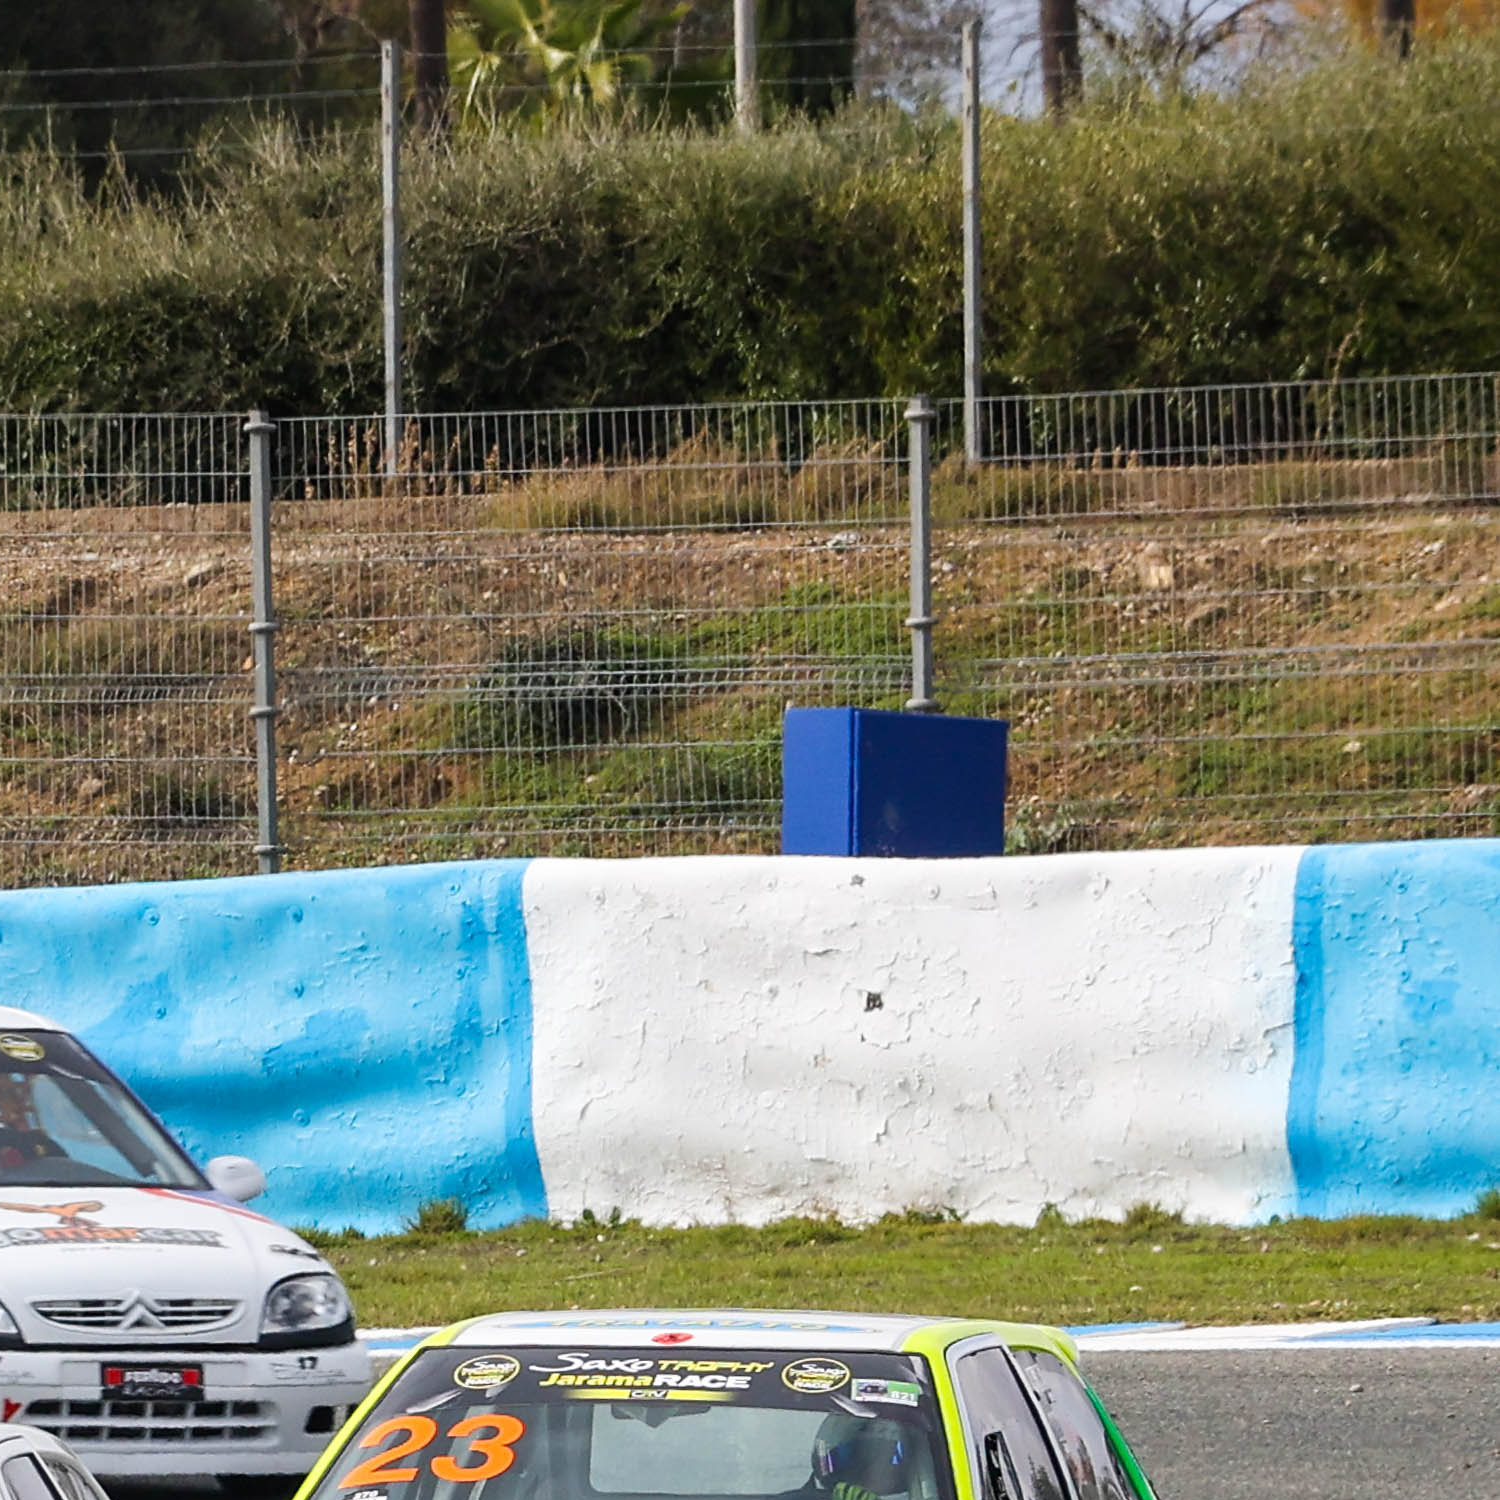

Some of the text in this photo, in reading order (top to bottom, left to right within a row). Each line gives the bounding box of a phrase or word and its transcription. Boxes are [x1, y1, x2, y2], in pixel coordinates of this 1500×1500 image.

[529, 1352, 775, 1374] Saxo TROPHY
[337, 1413, 526, 1489] 23
